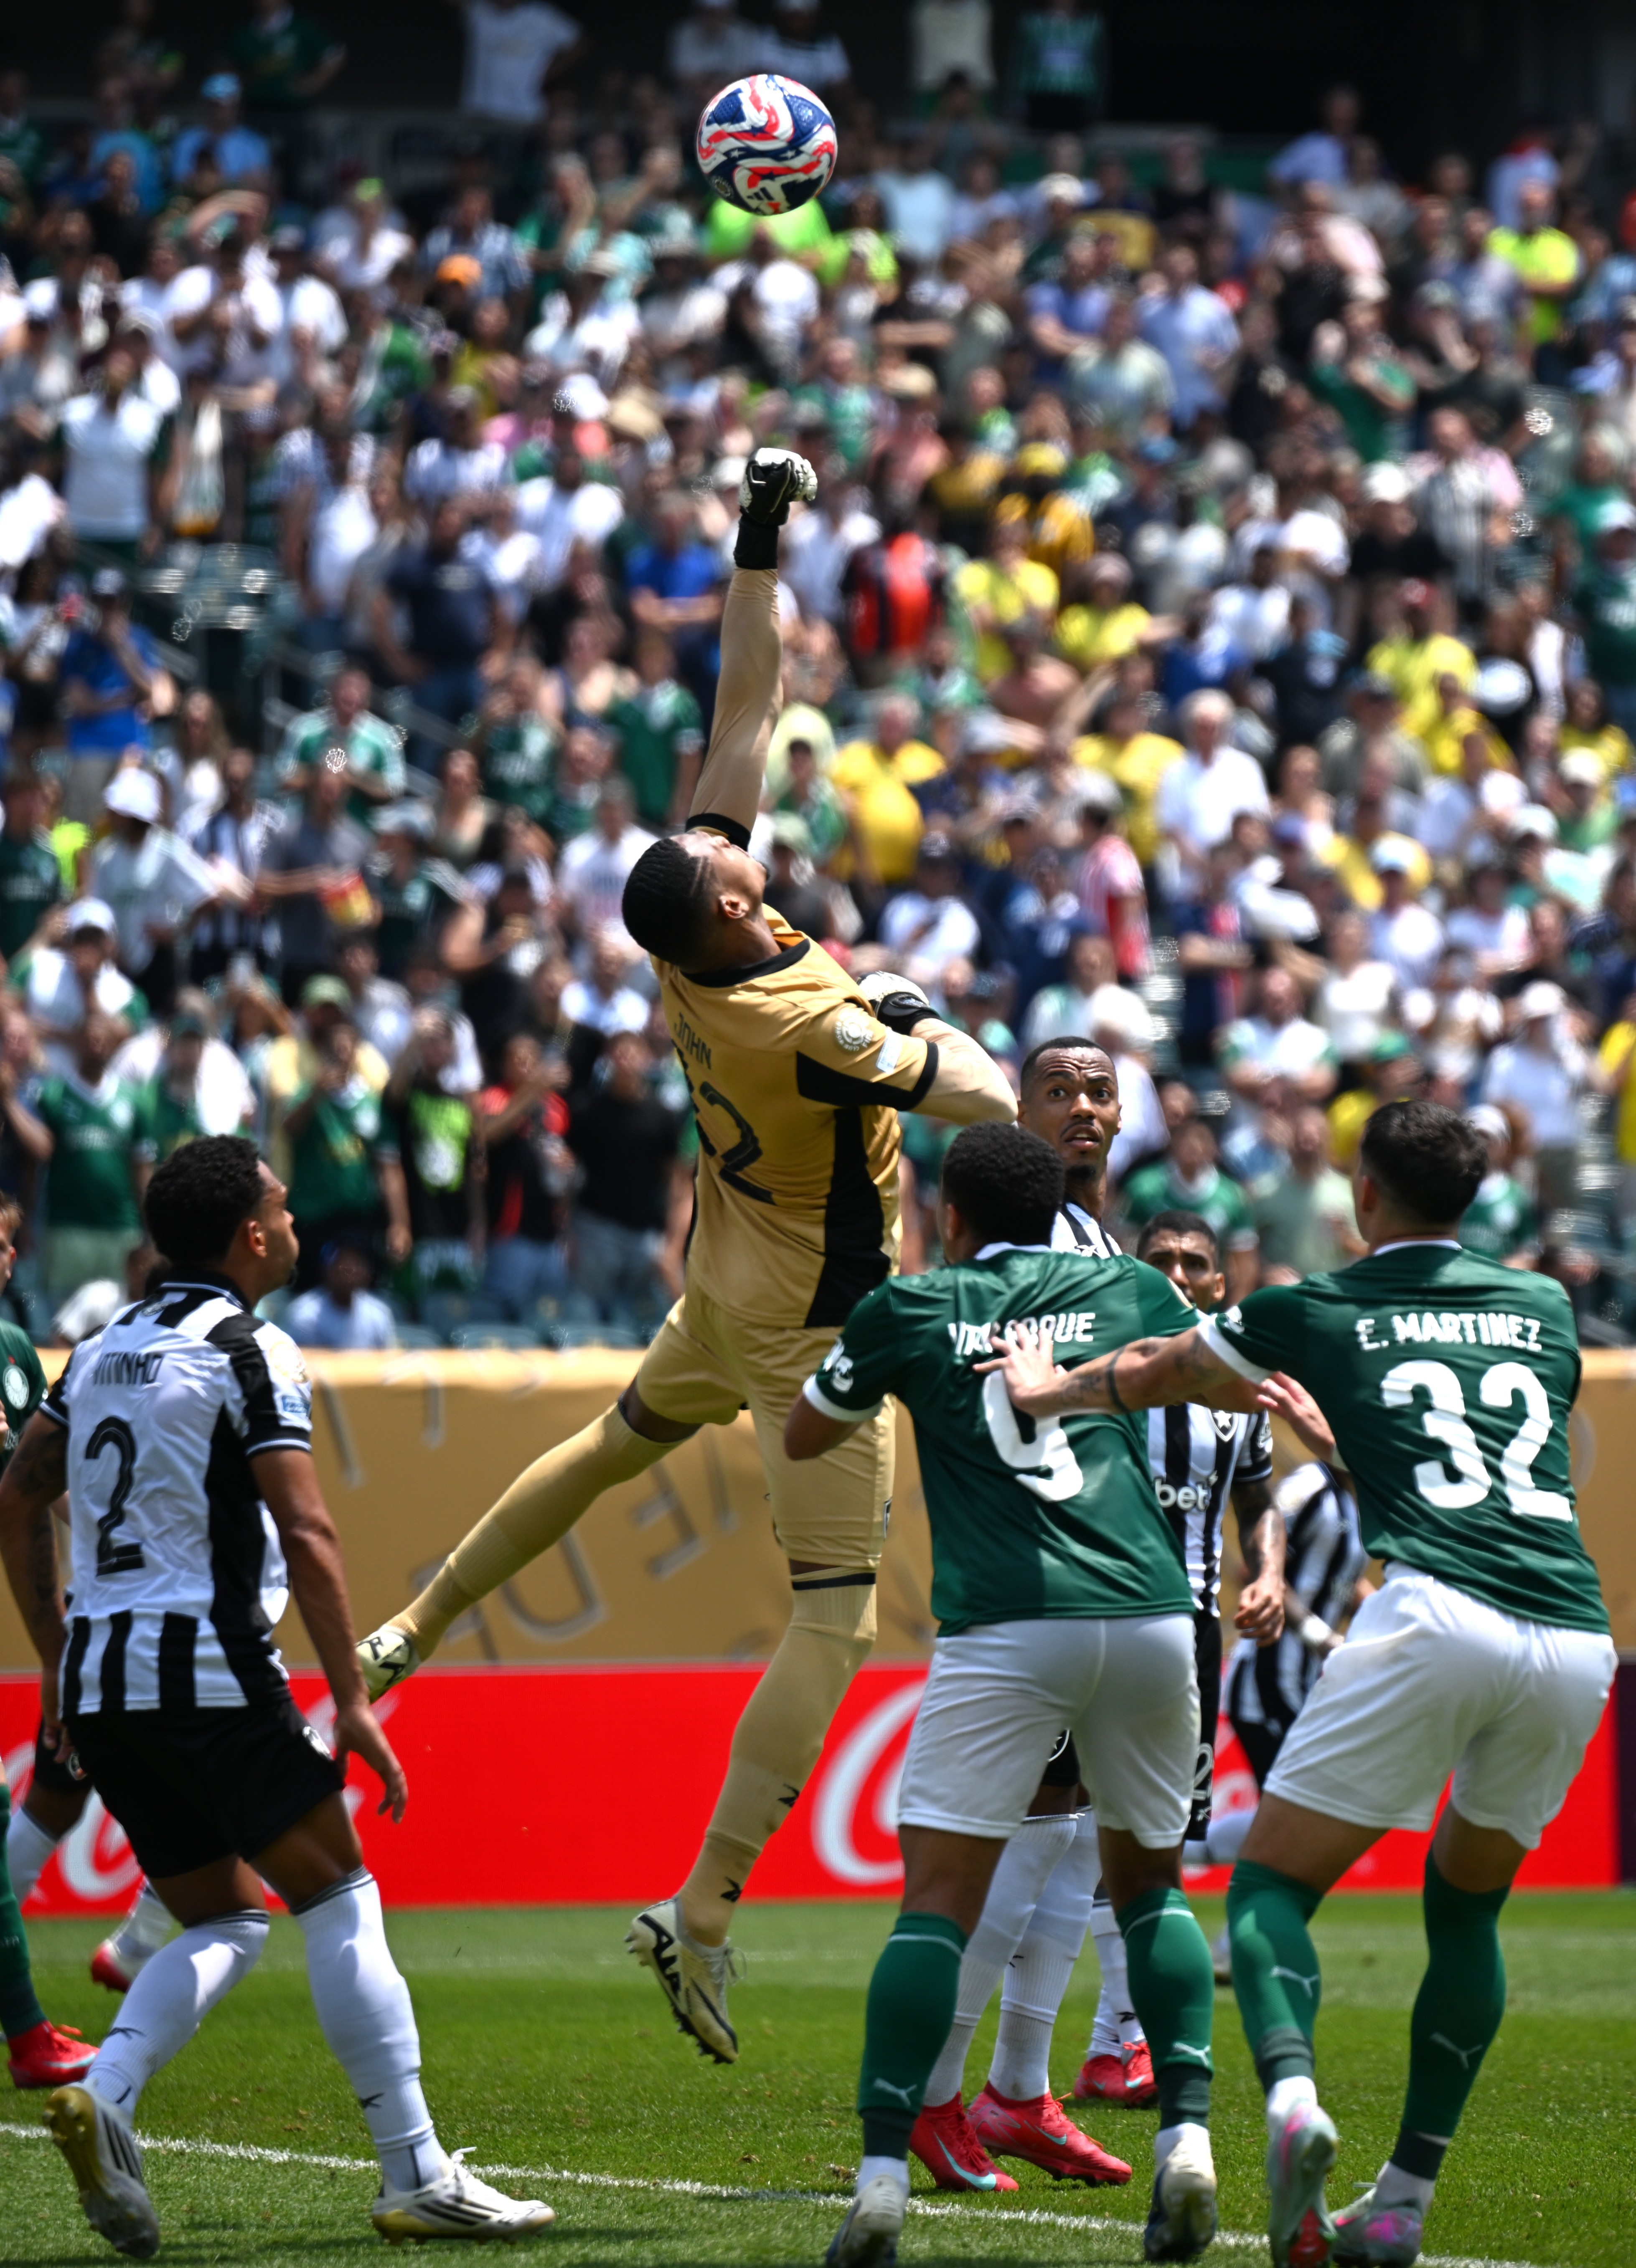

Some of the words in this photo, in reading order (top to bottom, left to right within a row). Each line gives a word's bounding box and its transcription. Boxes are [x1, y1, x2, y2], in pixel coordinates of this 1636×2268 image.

[674, 1012, 711, 1070] JOHN
[1355, 1318, 1389, 1351] E.
[1390, 1312, 1542, 1352] MARTINEZ
[85, 1415, 146, 1577] 2
[1381, 1359, 1574, 1523] 32
